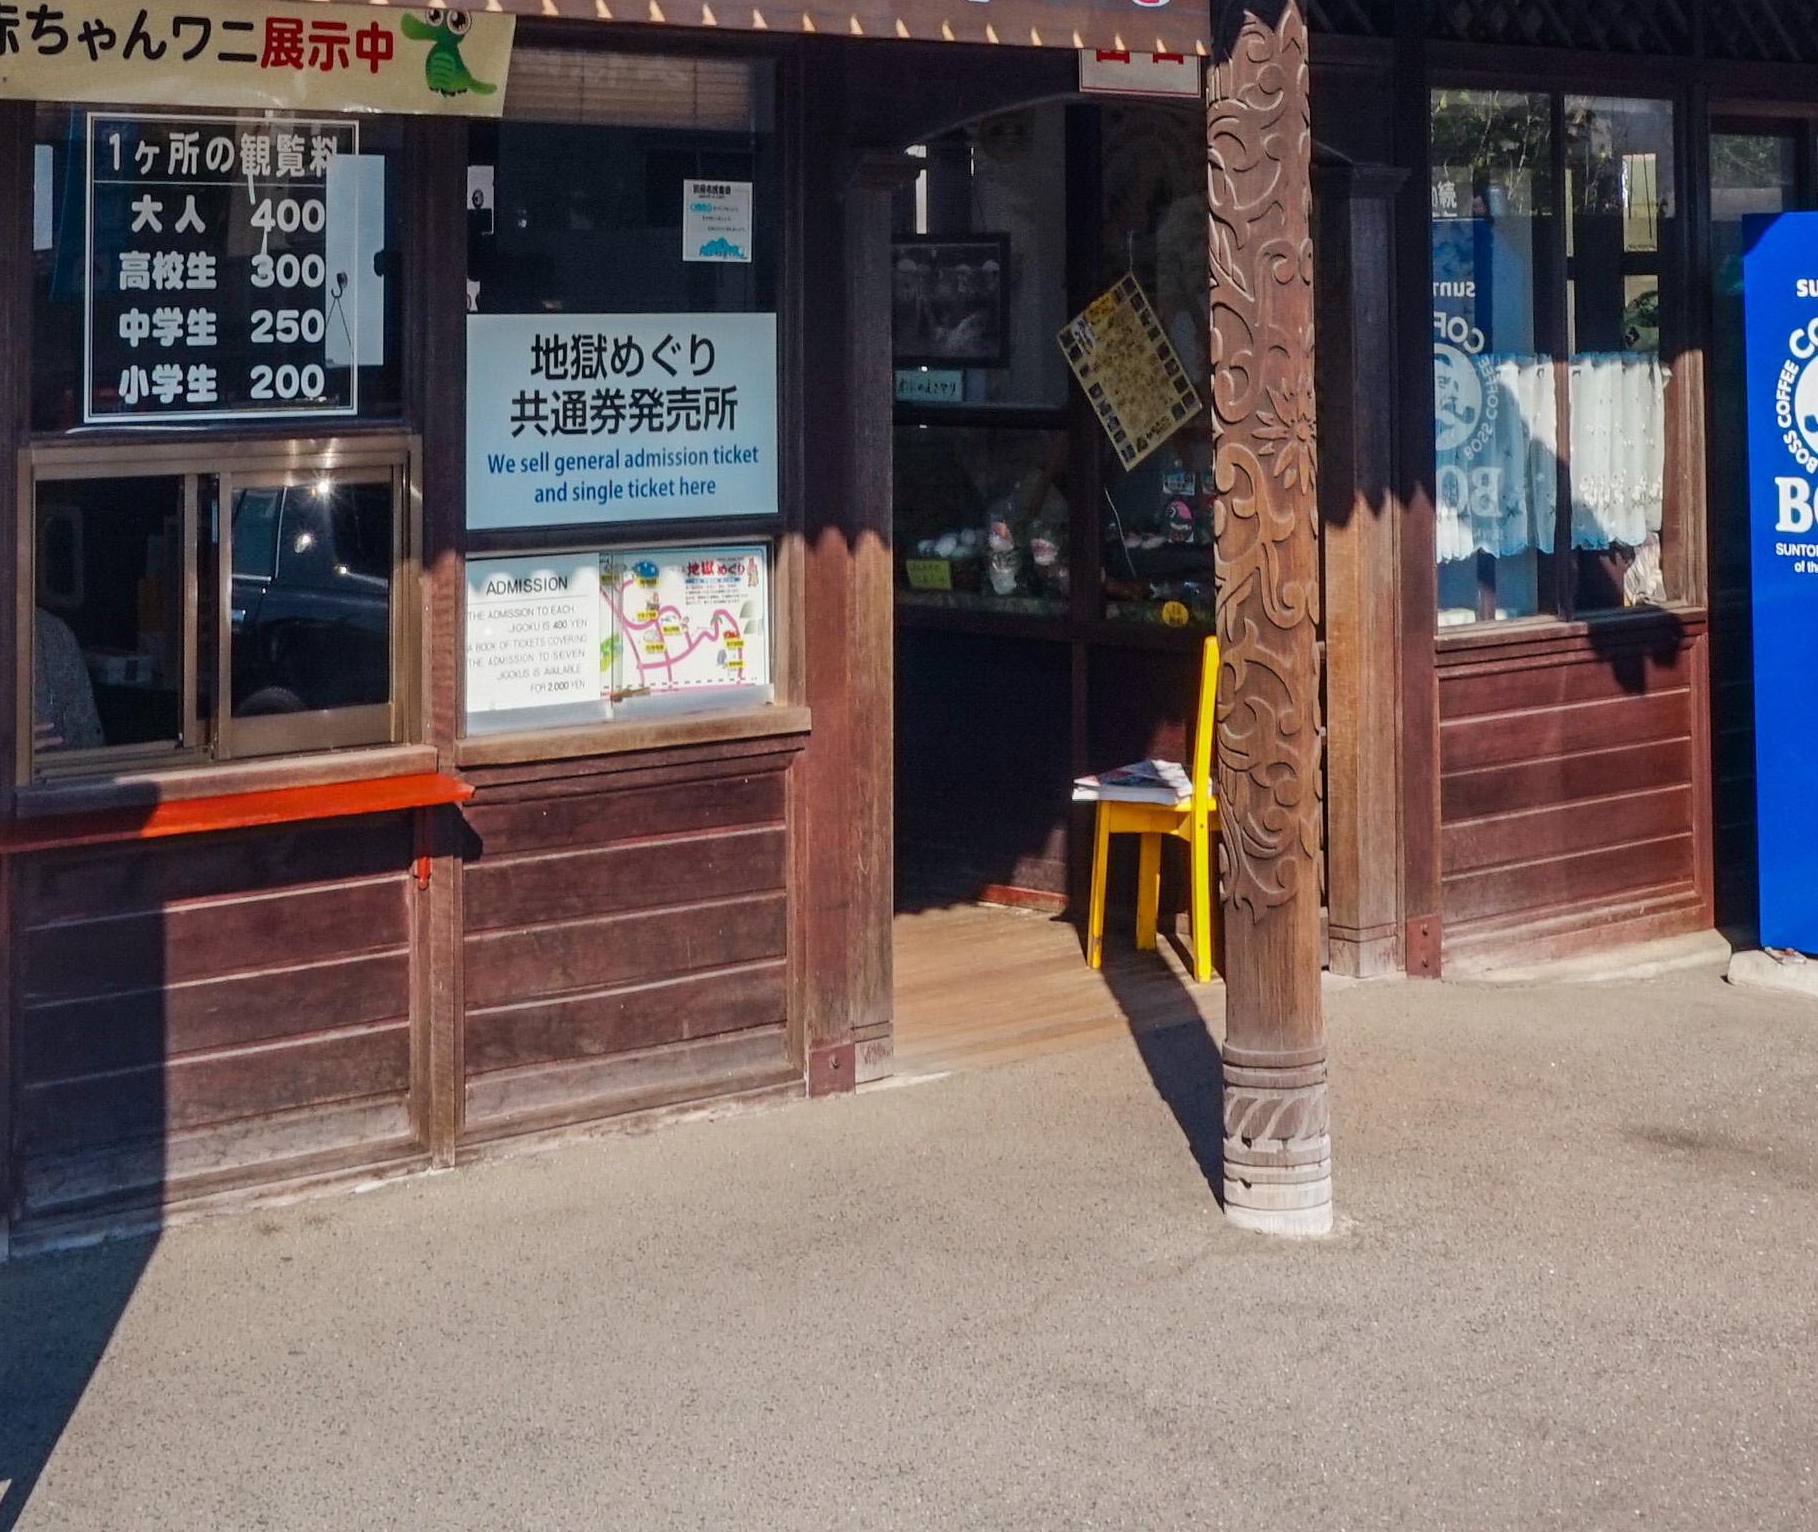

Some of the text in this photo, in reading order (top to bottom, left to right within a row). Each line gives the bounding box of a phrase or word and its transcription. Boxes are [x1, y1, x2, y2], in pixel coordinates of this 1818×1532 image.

[130, 194, 326, 234] 大人 400
[119, 250, 326, 291] 高校生 300
[119, 307, 326, 348] 中学生 250
[530, 332, 716, 381] 地獄めぐり
[118, 363, 325, 404] 小学生 200
[510, 385, 739, 438] 共通券発売所
[1775, 359, 1818, 474] BOSS COFFEE
[487, 444, 759, 476] We sell general admission ticket
[534, 476, 716, 505] and single ticket here
[1794, 561, 1806, 573] of
[486, 576, 569, 596] ADMISSION
[488, 607, 534, 620] ADMISSION
[537, 606, 549, 617] TO
[550, 604, 575, 616] EACH
[552, 620, 568, 629] 400
[488, 654, 534, 666] ADMISSION
[553, 650, 585, 660] SEVEN
